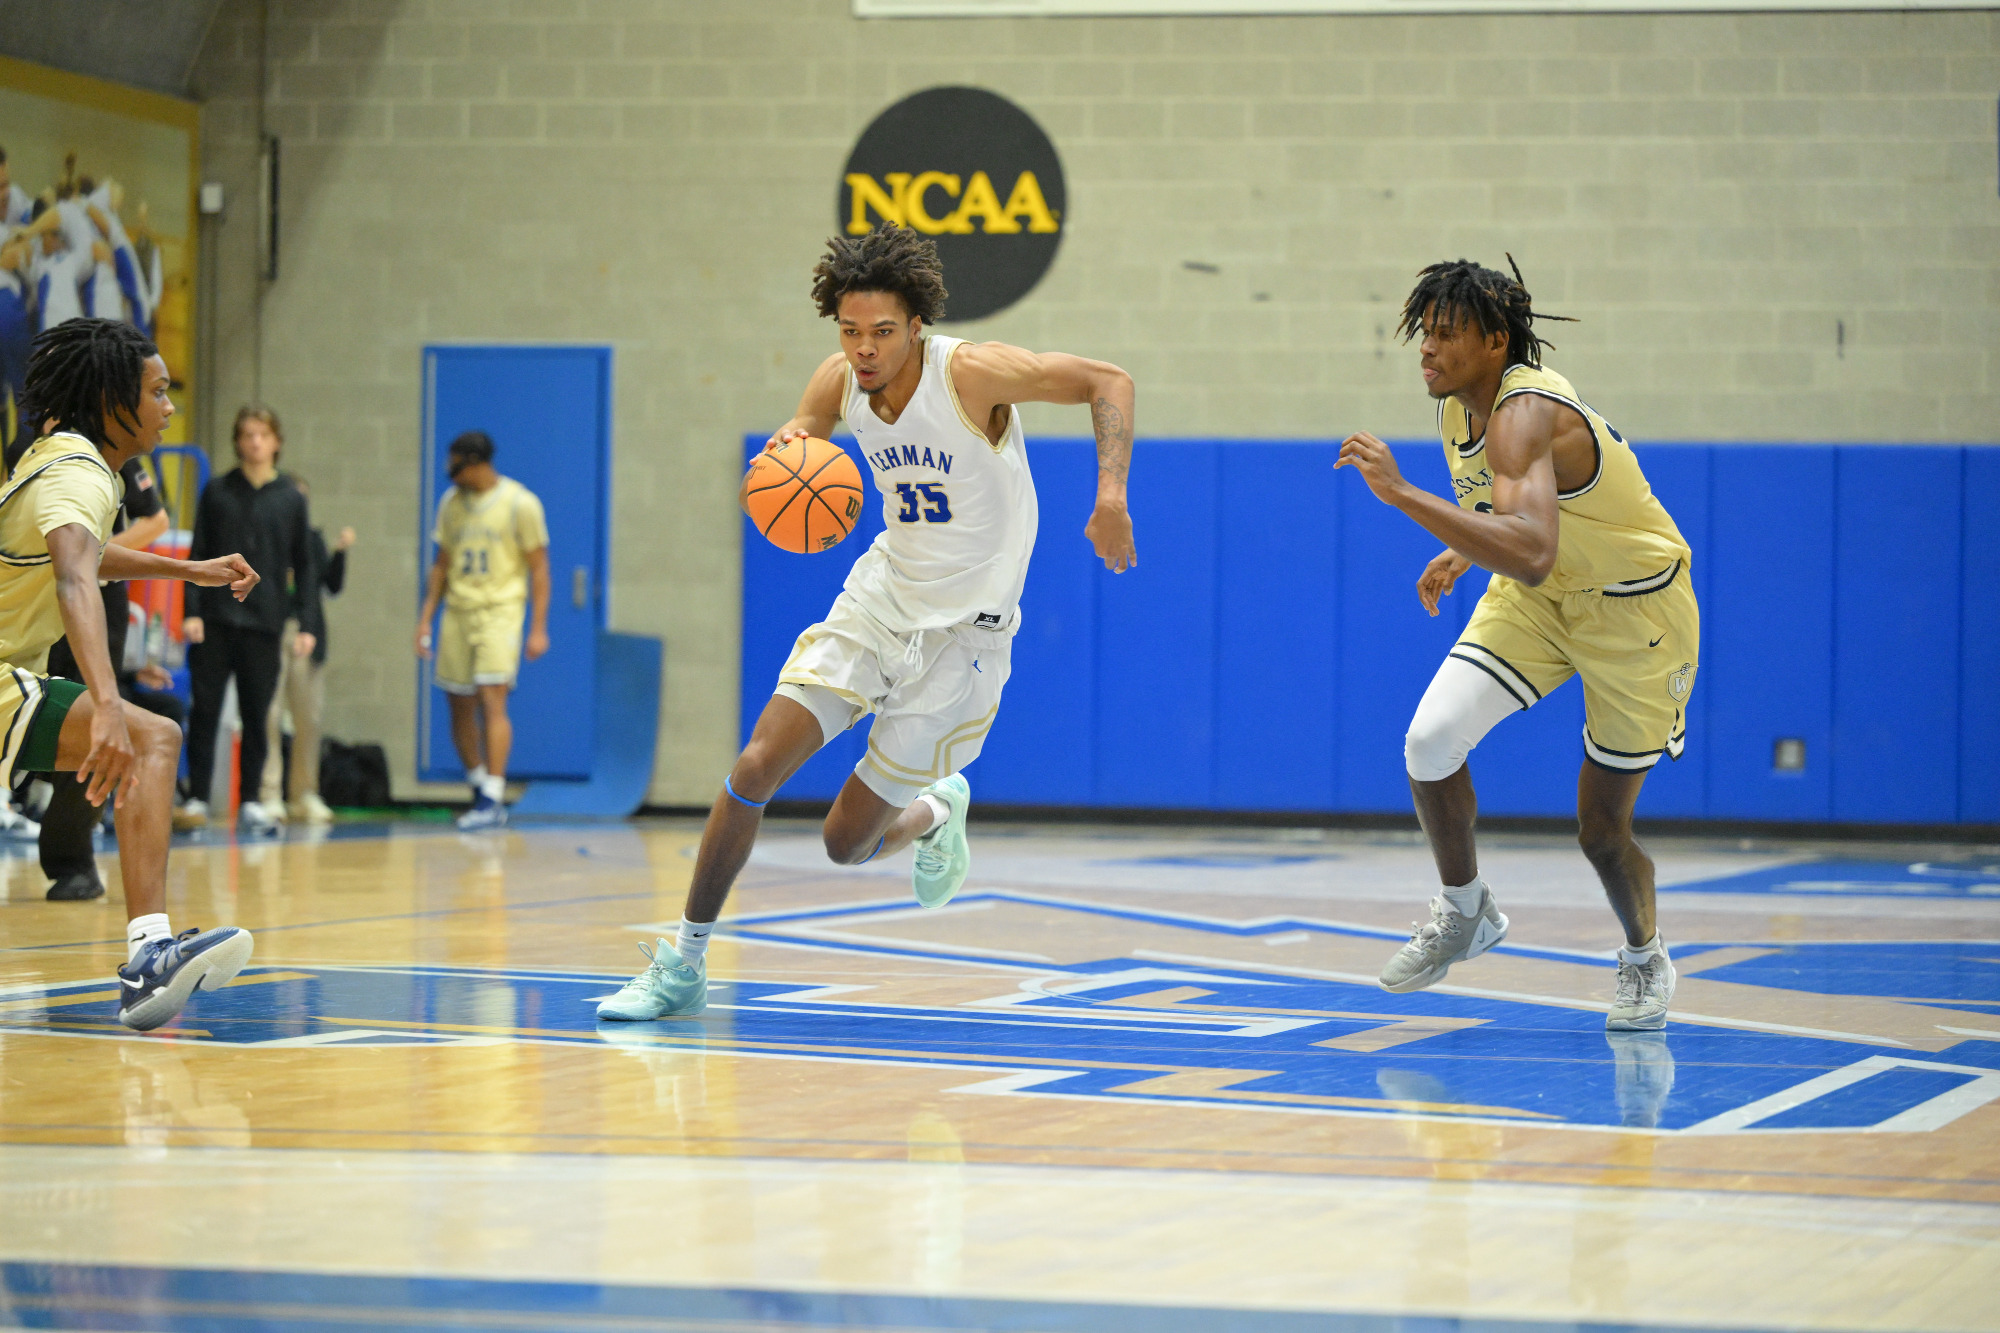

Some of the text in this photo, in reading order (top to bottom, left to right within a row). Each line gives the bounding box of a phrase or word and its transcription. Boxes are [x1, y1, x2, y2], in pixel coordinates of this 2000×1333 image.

[845, 170, 1059, 235] NCAA
[868, 444, 954, 475] LEHMAN
[892, 481, 954, 525] 35
[1674, 672, 1691, 694] W
